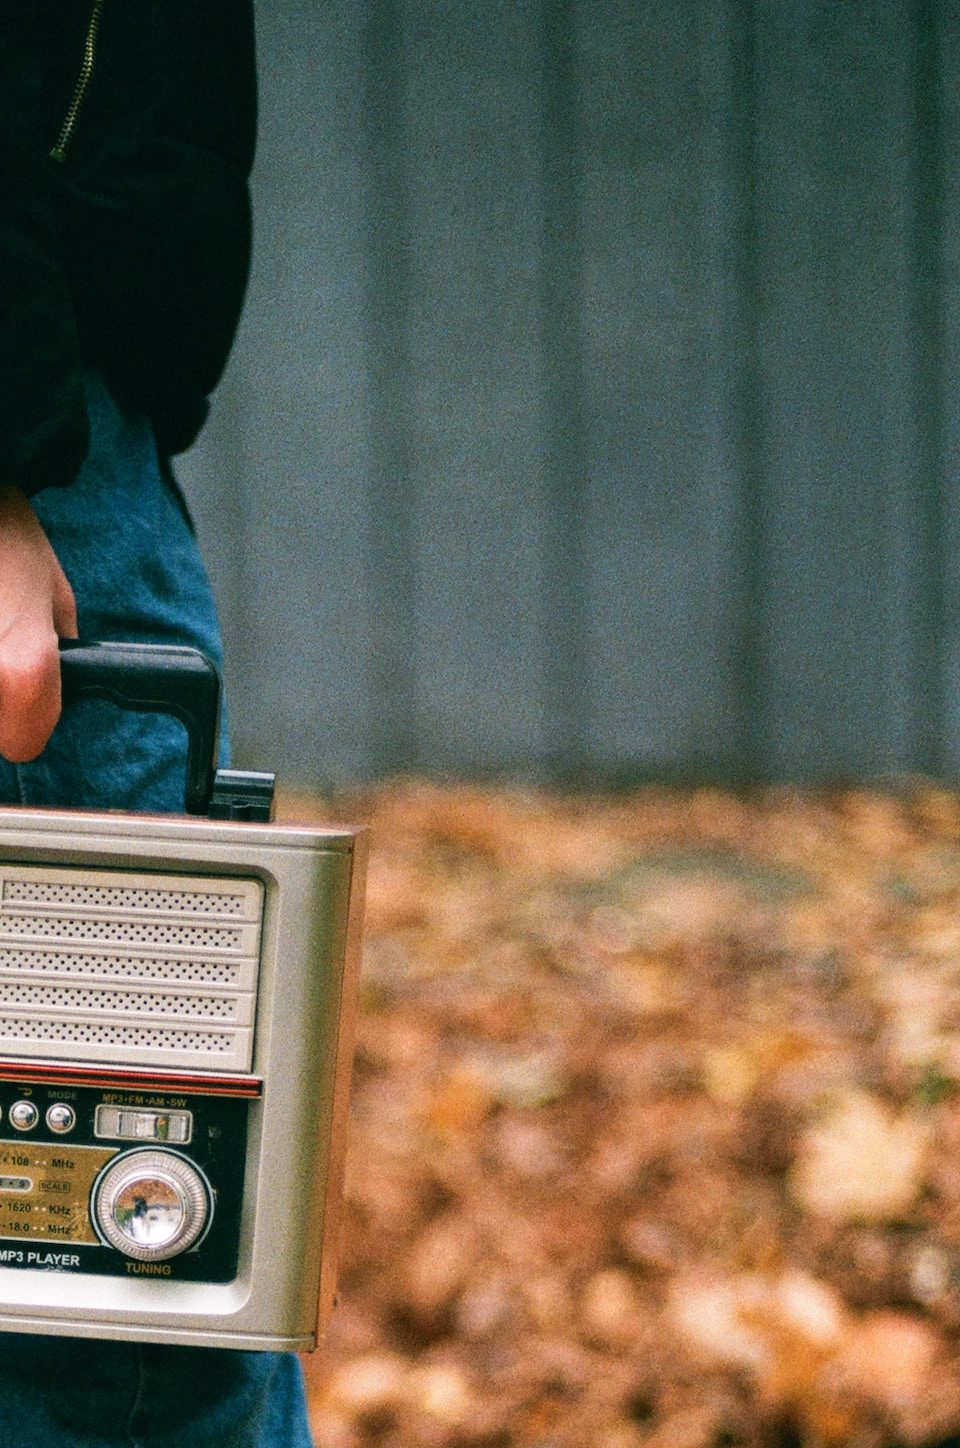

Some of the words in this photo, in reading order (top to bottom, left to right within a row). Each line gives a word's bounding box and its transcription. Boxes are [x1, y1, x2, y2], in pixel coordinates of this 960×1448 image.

[47, 1090, 77, 1100] MODE
[11, 1156, 30, 1167] 108
[51, 1158, 75, 1169] MHz
[41, 1181, 68, 1191] SCALE
[8, 1202, 31, 1213] 1620
[48, 1205, 71, 1216] KHz
[9, 1222, 30, 1232] 18.0
[47, 1224, 71, 1235] MHz
[27, 1251, 81, 1266] PLAYER
[125, 1262, 171, 1275] TUNING
